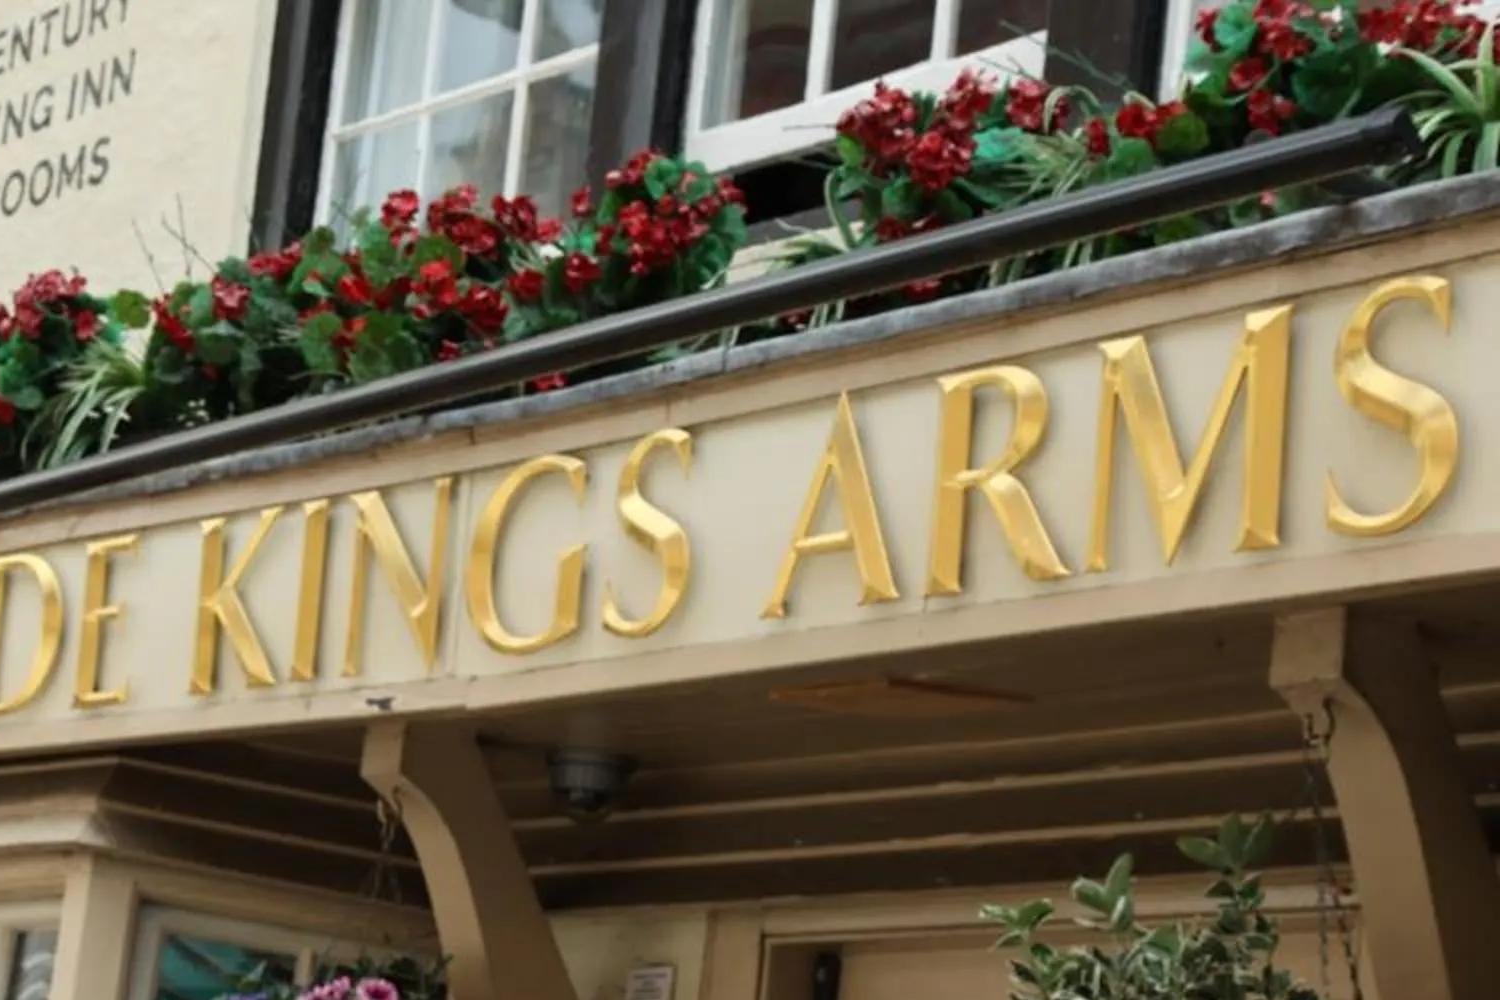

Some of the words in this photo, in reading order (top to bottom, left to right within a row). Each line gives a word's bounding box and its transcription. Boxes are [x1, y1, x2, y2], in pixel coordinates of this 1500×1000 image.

[66, 48, 137, 121] INN
[189, 427, 695, 696] KINGS
[758, 274, 1460, 620] ARMS
